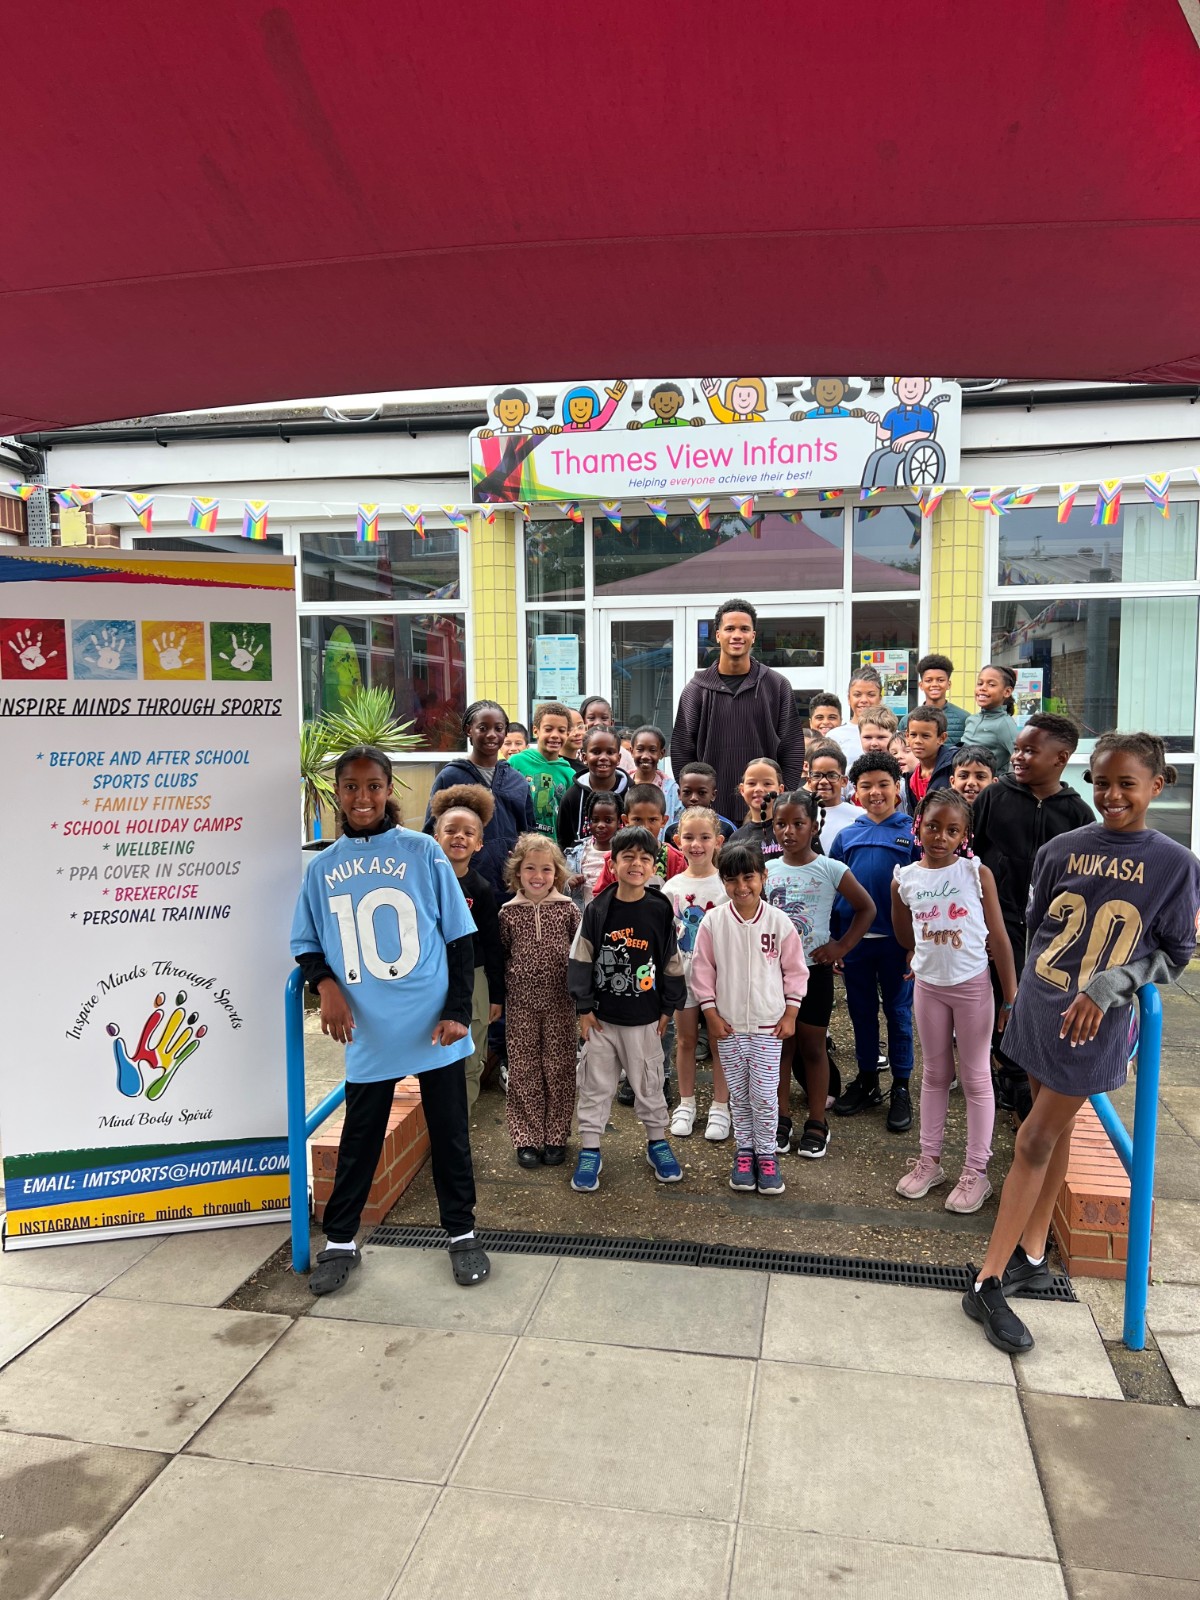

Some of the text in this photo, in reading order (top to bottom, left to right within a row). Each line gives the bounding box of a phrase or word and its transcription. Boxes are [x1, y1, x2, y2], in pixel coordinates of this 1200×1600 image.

[551, 437, 838, 475] Thames View Infants
[628, 469, 812, 489] Helping everyone achieve their best!
[0, 698, 281, 715] NSPIRE MINDS THROUGH SPORTS
[49, 750, 250, 766] BEFORE AND AFTER SCHOOL
[93, 773, 198, 789] SPORTS CLUBS
[94, 795, 212, 812] FAMILY FITNESS
[63, 817, 243, 836] SCHOOL HOLIDAY CAMPS
[115, 840, 195, 857] WELLBEING
[69, 861, 241, 881] PPA COVER IN SCHOOLS
[324, 856, 408, 890] MUKASA
[1067, 853, 1145, 884] MUKASA
[114, 885, 199, 901] BREXERCISE
[916, 881, 960, 899] smile
[83, 905, 231, 925] PERSONAL TRAINING
[915, 903, 968, 920] and be
[328, 886, 421, 985] 10
[610, 927, 634, 942] BEEP!
[626, 938, 649, 951] BEEP!
[921, 922, 962, 949] happy
[1035, 891, 1143, 992] 20
[66, 961, 242, 1040] Inspire Minds Through Sports
[99, 1108, 213, 1129] Mind Body Spirit
[23, 1154, 290, 1194] EMAIL: IMTSPORTS@HOTMAIL.COM
[102, 1210, 145, 1226] inspire
[156, 1205, 193, 1220] minds
[203, 1199, 251, 1216] through
